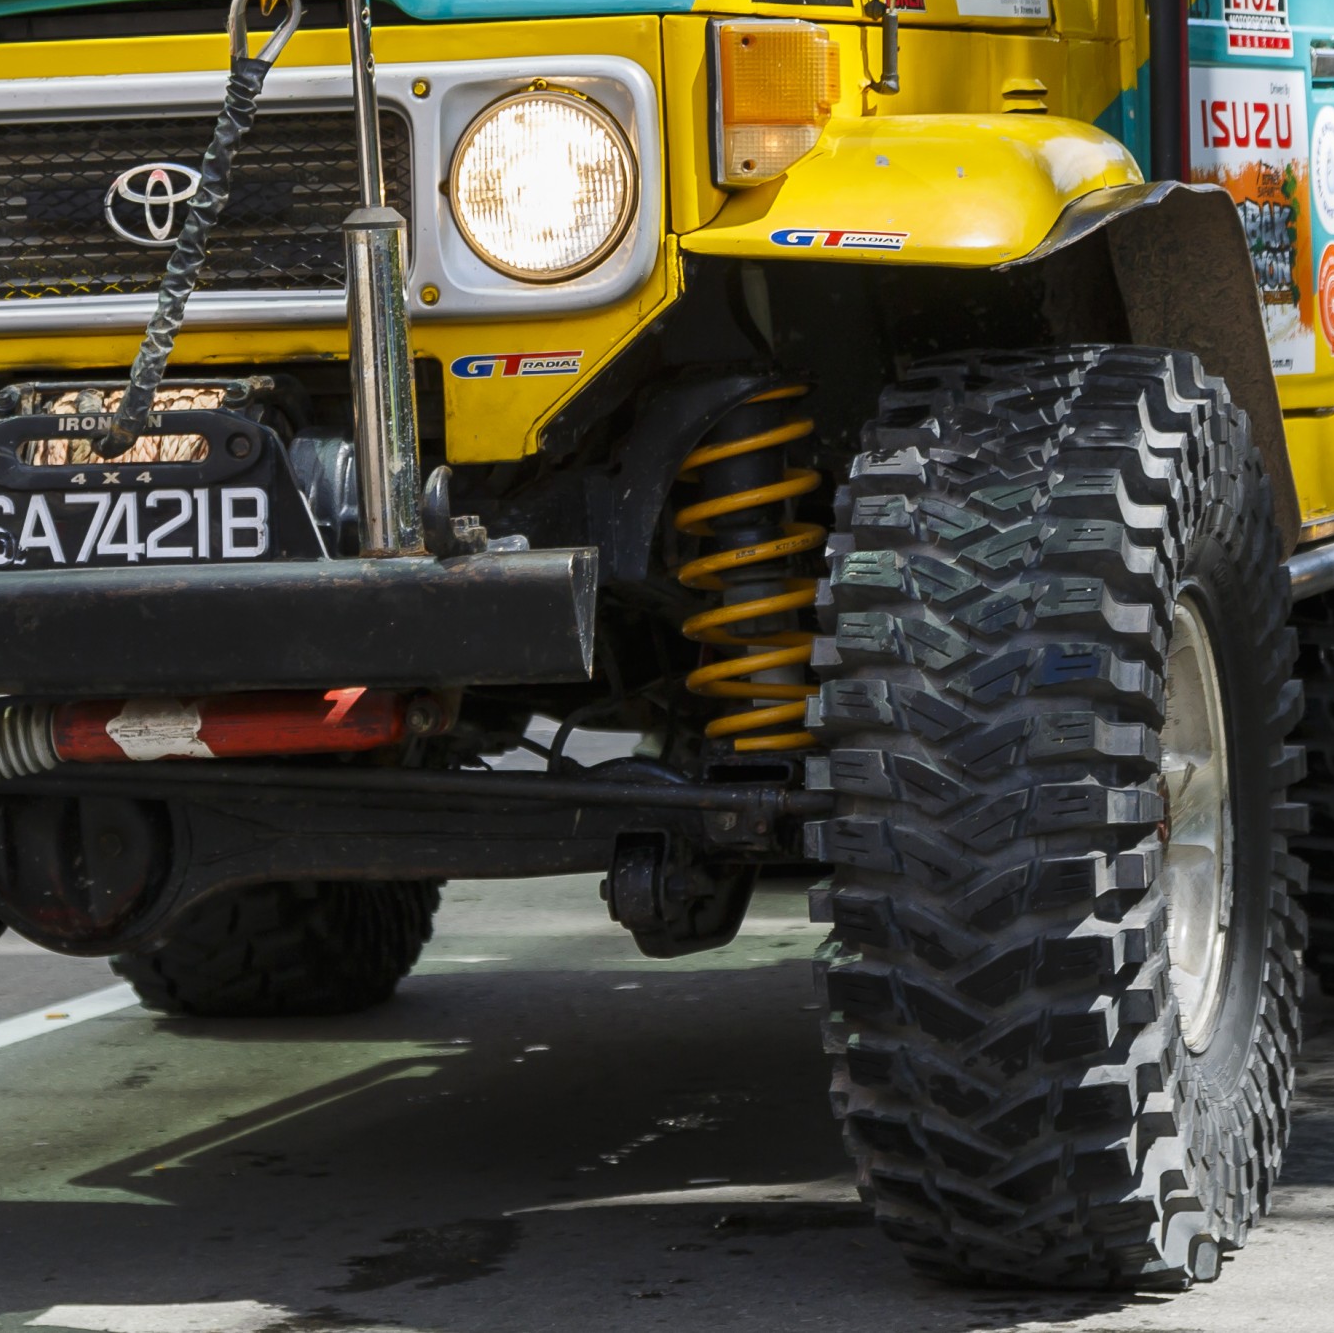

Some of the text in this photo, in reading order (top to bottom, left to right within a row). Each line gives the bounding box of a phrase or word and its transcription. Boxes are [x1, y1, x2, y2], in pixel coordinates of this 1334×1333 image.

[1201, 99, 1292, 149] ISUZU
[1238, 197, 1292, 249] BAK
[845, 236, 903, 244] RADIAL
[523, 360, 580, 368] RADIAL
[58, 415, 163, 431] IRONN
[70, 471, 152, 485] 4 X 4
